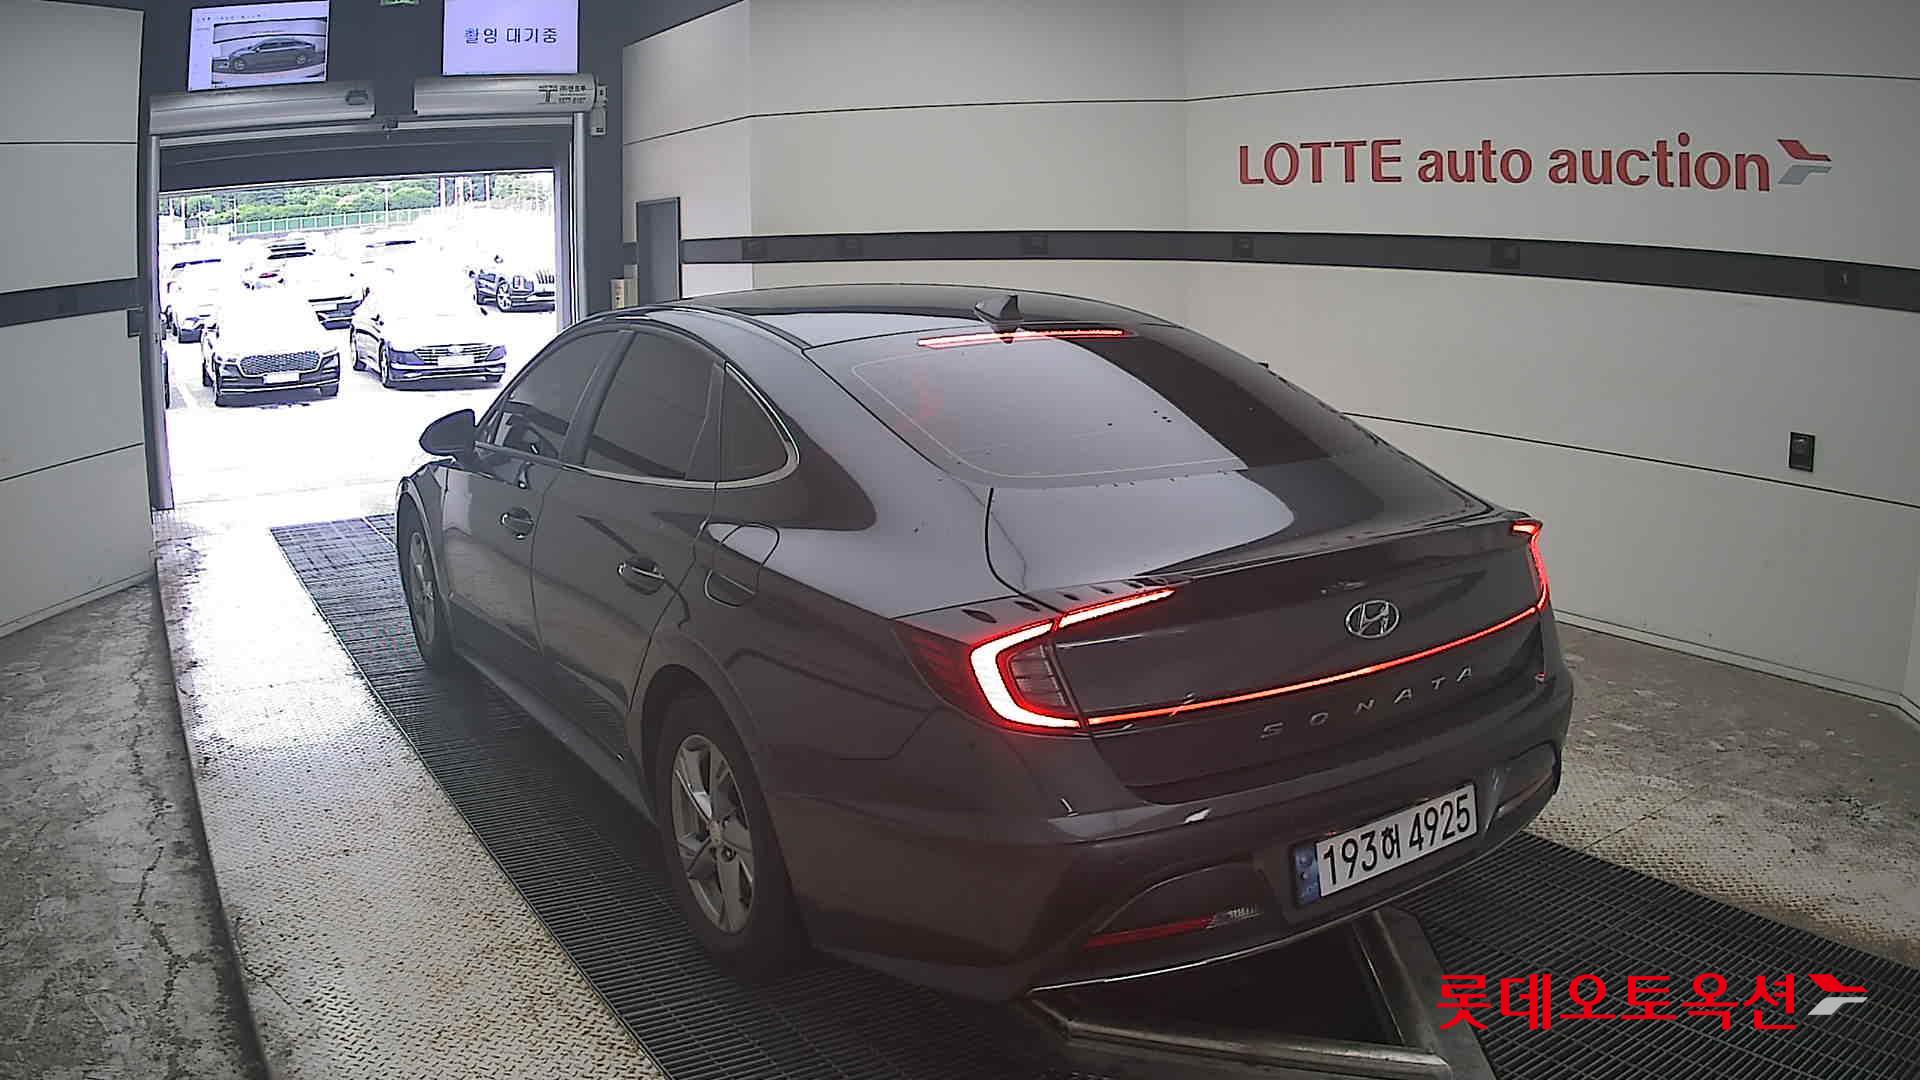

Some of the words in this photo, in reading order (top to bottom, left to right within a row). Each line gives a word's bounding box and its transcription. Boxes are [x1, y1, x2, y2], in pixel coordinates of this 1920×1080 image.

[505, 27, 558, 44] 대기중
[1238, 139, 1402, 185] LOTTE
[1417, 139, 1533, 184] auto
[1547, 132, 1771, 192] auction
[1260, 665, 1473, 739] SONATA
[1323, 824, 1401, 886] 193허
[1408, 793, 1471, 851] 4925
